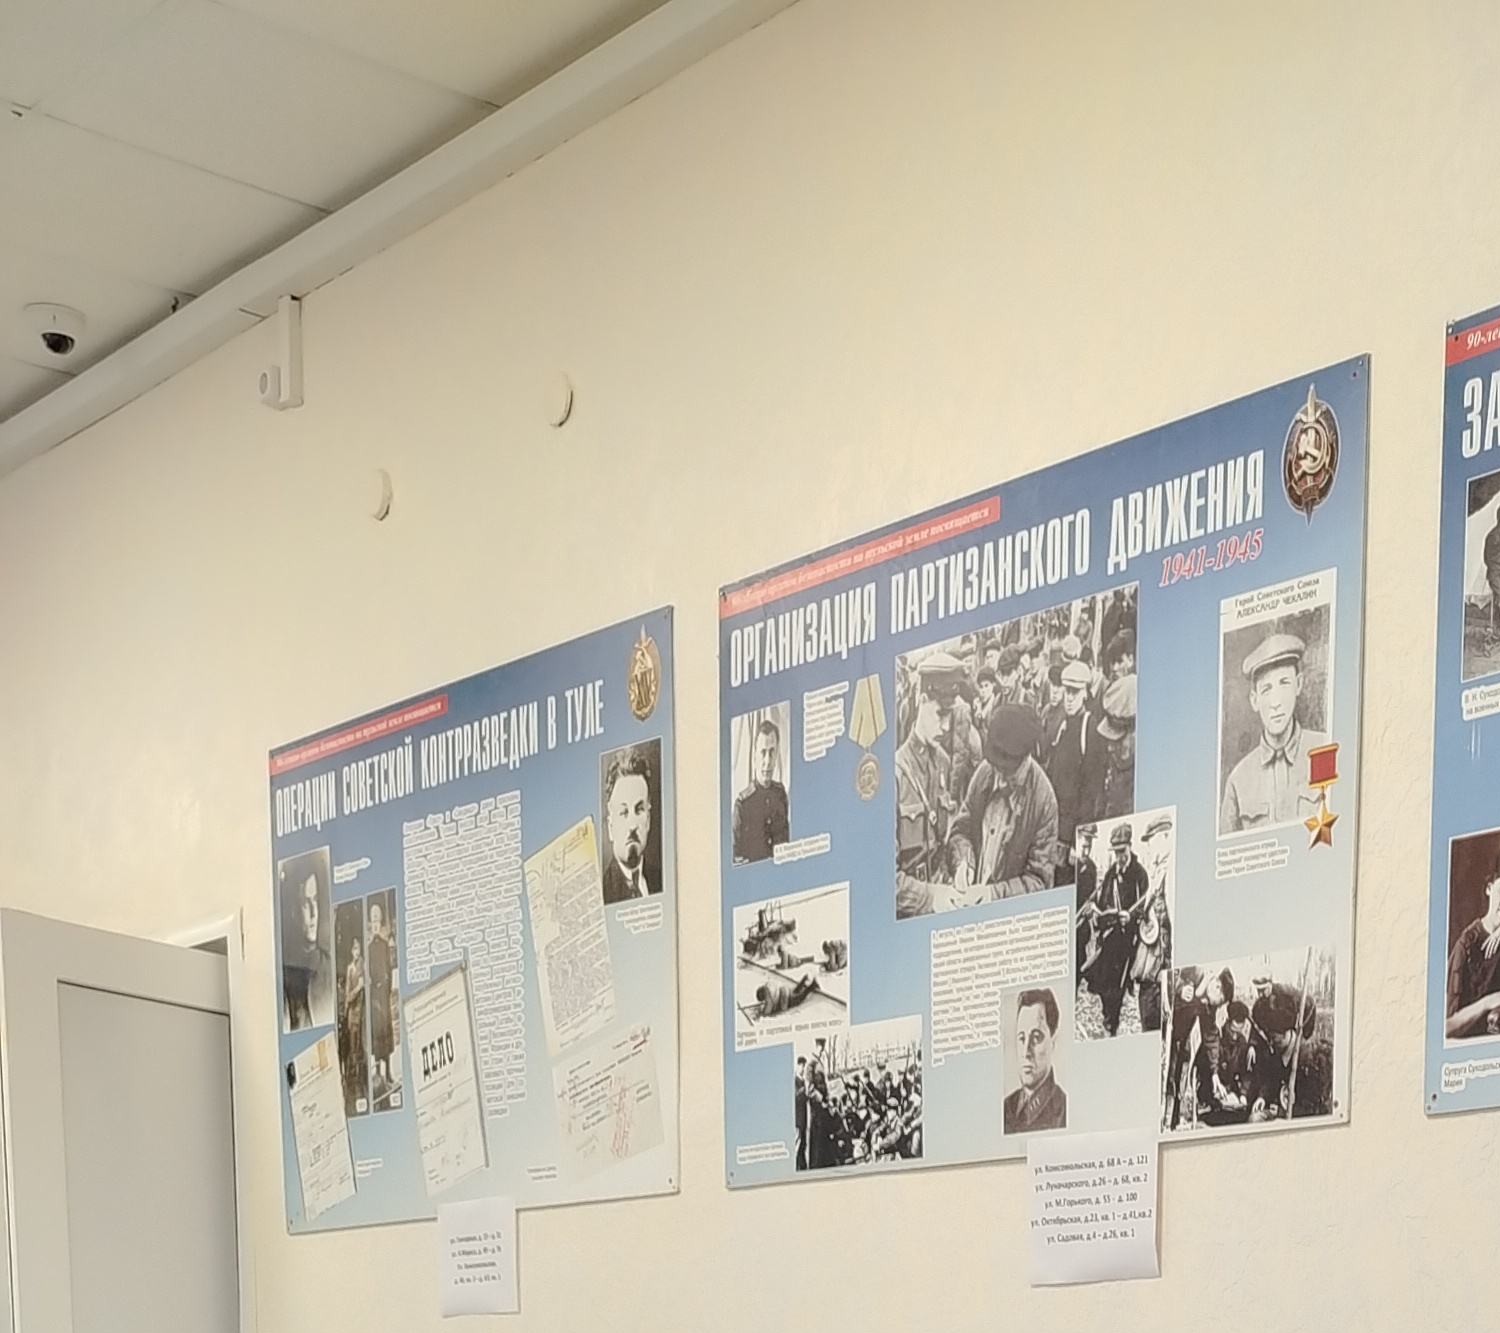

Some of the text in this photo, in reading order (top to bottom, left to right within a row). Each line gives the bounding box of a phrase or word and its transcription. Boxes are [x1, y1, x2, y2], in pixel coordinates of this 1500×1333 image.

[730, 449, 1265, 688] ОРГАНИЗАЦИЯ ПАРТИЗАНСКОГО ДВИЖЕНИЯ
[1158, 529, 1264, 589] 1941-1945
[275, 770, 336, 838] ОПЕРАЦИИ
[343, 736, 414, 816] СОВЕТСКОЙ
[421, 701, 538, 790] КОНТРРАЗВЕДКИ
[548, 696, 557, 749] В
[565, 680, 604, 743] ТУЛЕ
[422, 1031, 454, 1082] ДЕЛО
